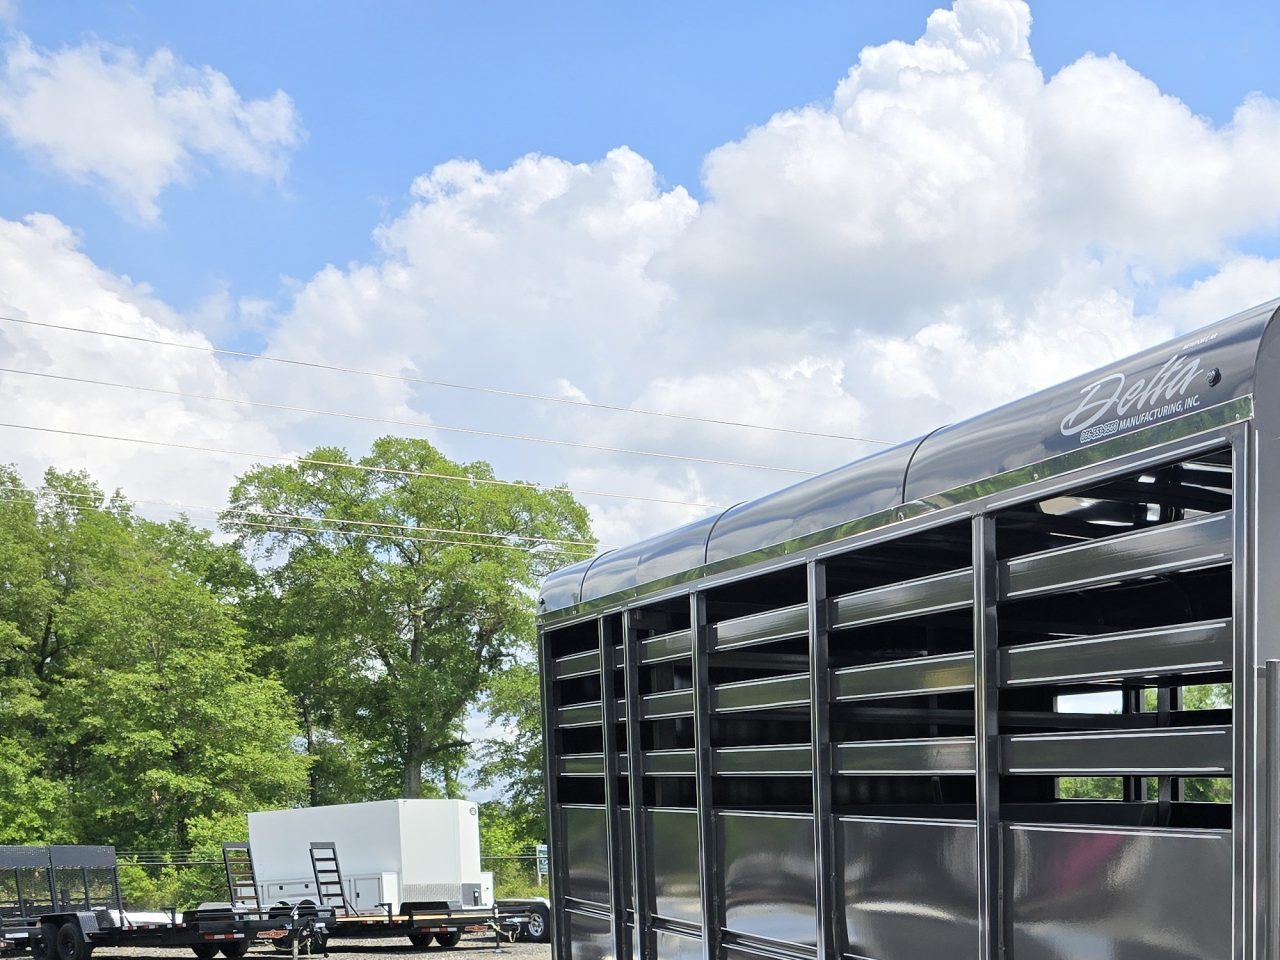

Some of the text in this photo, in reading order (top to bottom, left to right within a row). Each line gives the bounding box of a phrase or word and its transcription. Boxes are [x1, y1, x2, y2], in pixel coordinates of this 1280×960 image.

[1061, 354, 1203, 436] Delta
[1119, 394, 1200, 430] MANUFACTURING, INC.
